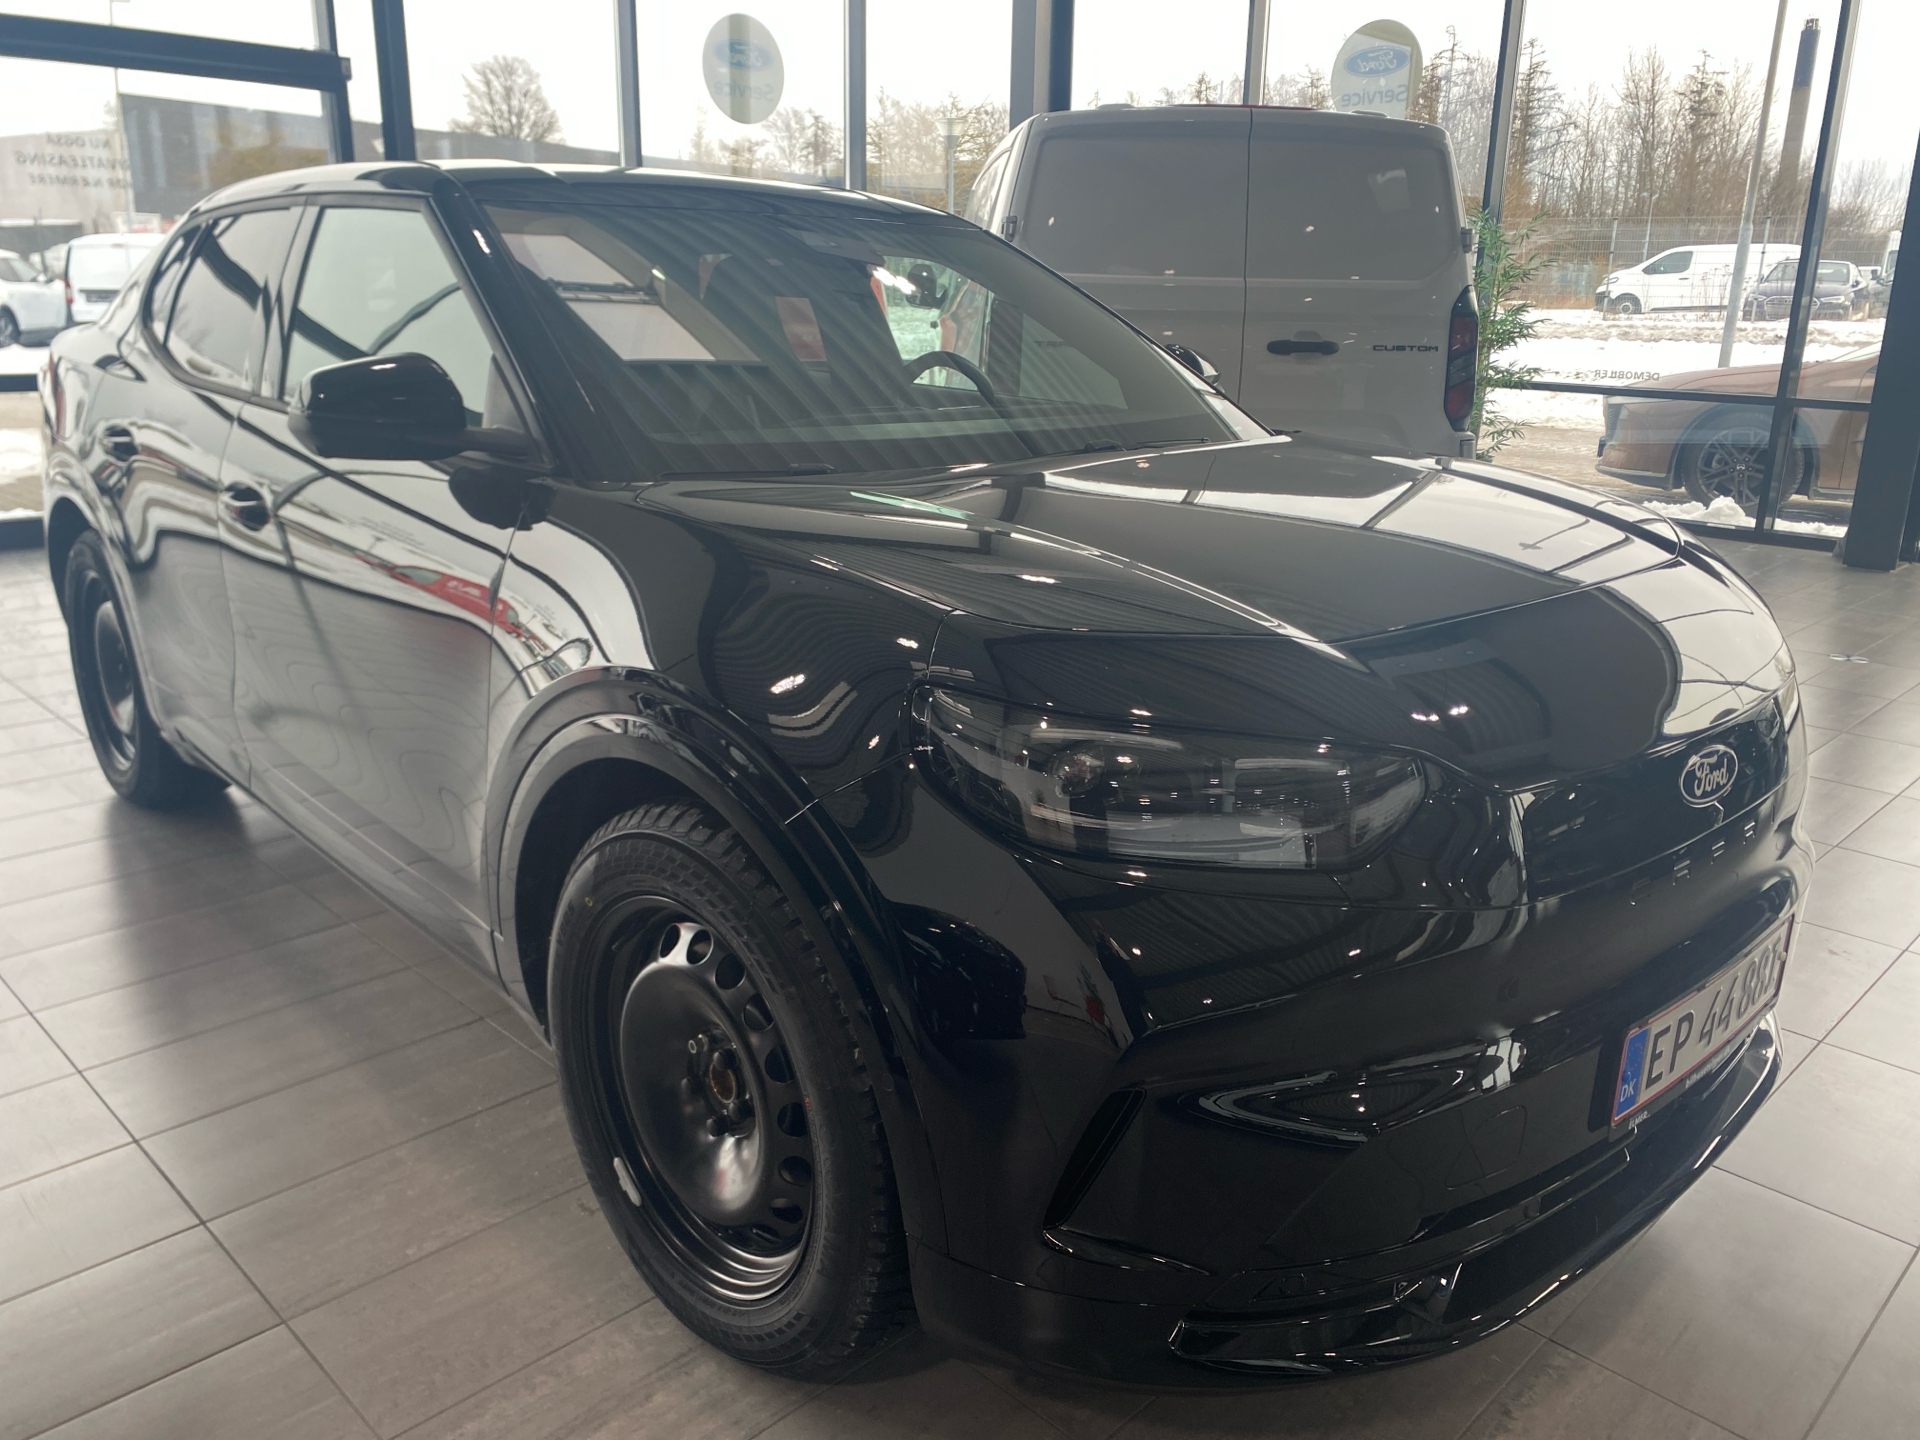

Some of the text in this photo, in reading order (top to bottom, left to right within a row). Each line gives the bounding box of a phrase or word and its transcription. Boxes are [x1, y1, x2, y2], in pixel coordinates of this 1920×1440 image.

[1372, 344, 1439, 352] CUSTOM
[1694, 754, 1730, 796] Ford
[1645, 1010, 1696, 1090] EP
[1698, 972, 1741, 1046] 44
[1620, 1079, 1637, 1103] DK
